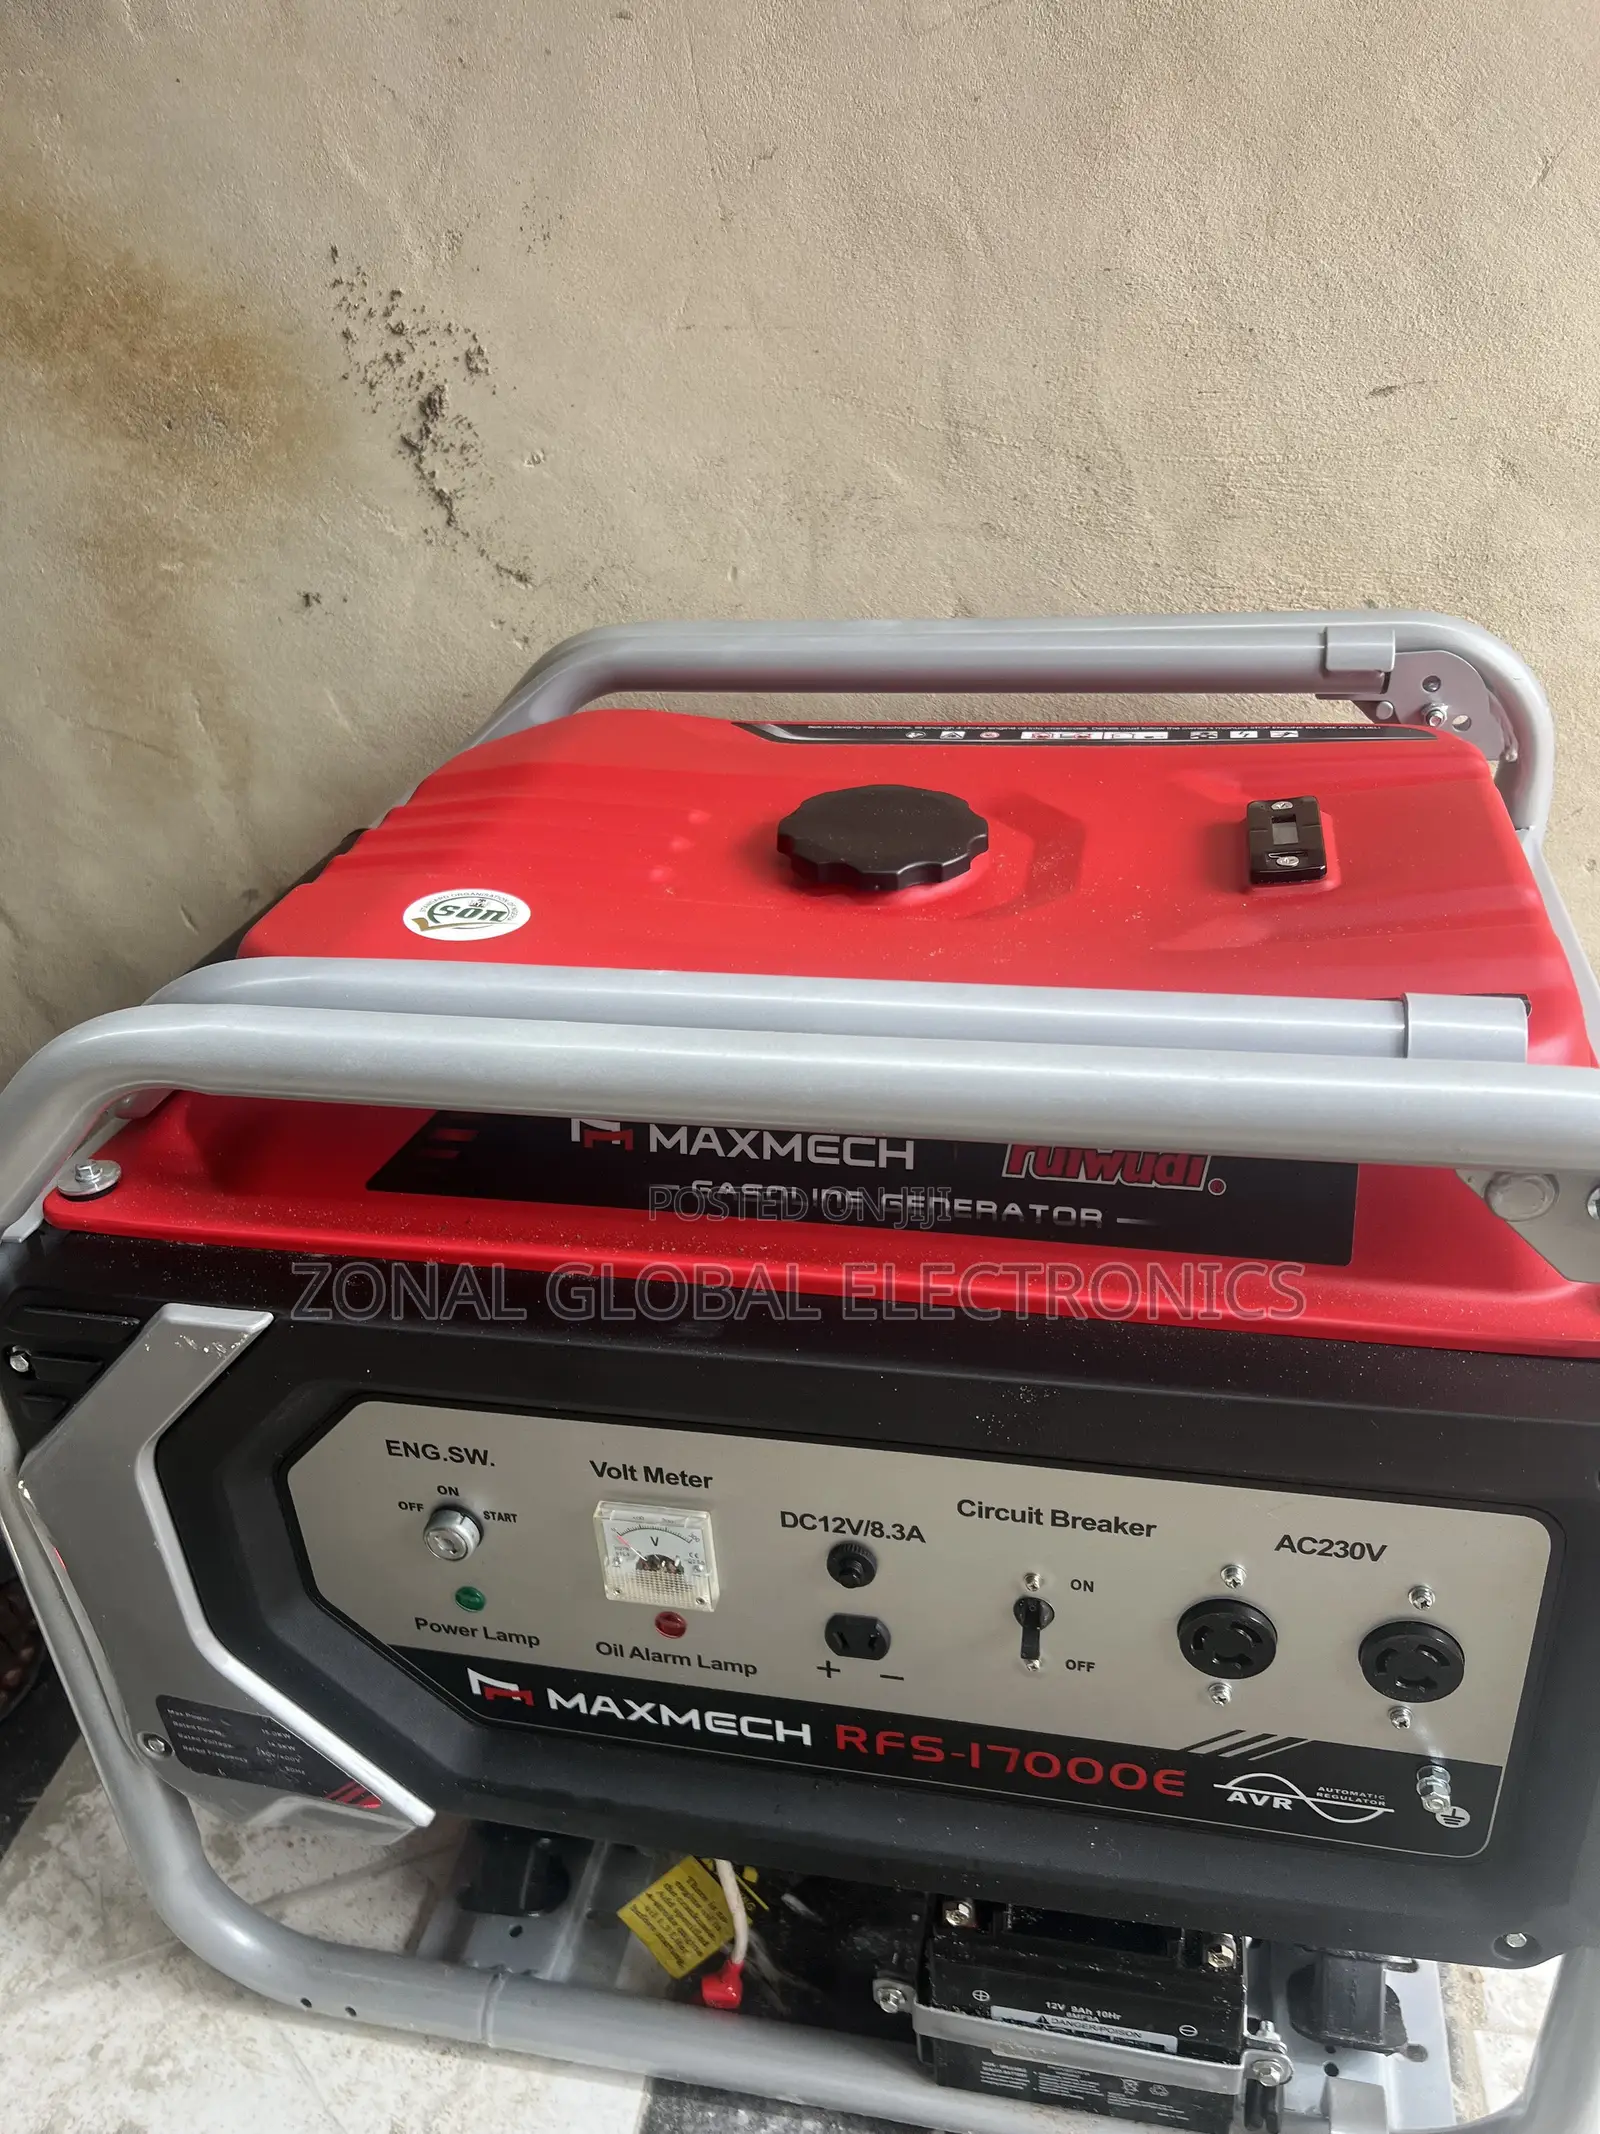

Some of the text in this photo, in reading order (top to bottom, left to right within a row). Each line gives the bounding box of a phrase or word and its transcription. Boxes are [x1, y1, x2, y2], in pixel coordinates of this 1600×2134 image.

[649, 1124, 915, 1170] MAXMECH
[691, 1180, 1103, 1228] GASOLINE GENERATOR
[385, 1440, 495, 1467] ENG.SW.
[589, 1460, 713, 1489] Volt Meter
[436, 1484, 459, 1497] ON
[398, 1501, 424, 1513] OFF
[483, 1509, 518, 1524] START
[957, 1499, 1157, 1538] Circuit Breaker
[780, 1510, 926, 1544] DC12V/8.3A
[650, 1536, 659, 1547] V
[1274, 1534, 1388, 1562] AC230V
[1070, 1578, 1094, 1593] ON
[414, 1616, 541, 1648] Power Lamp
[595, 1640, 758, 1678] Oil Alarm Lamp
[1065, 1659, 1096, 1674] OFF
[547, 1688, 812, 1747] MAXMECH
[1227, 1790, 1293, 1811] AVR
[1316, 1791, 1387, 1807] REGULATOR
[1317, 1786, 1386, 1801] AUTOMATIC
[1045, 2001, 1066, 2012] 12V
